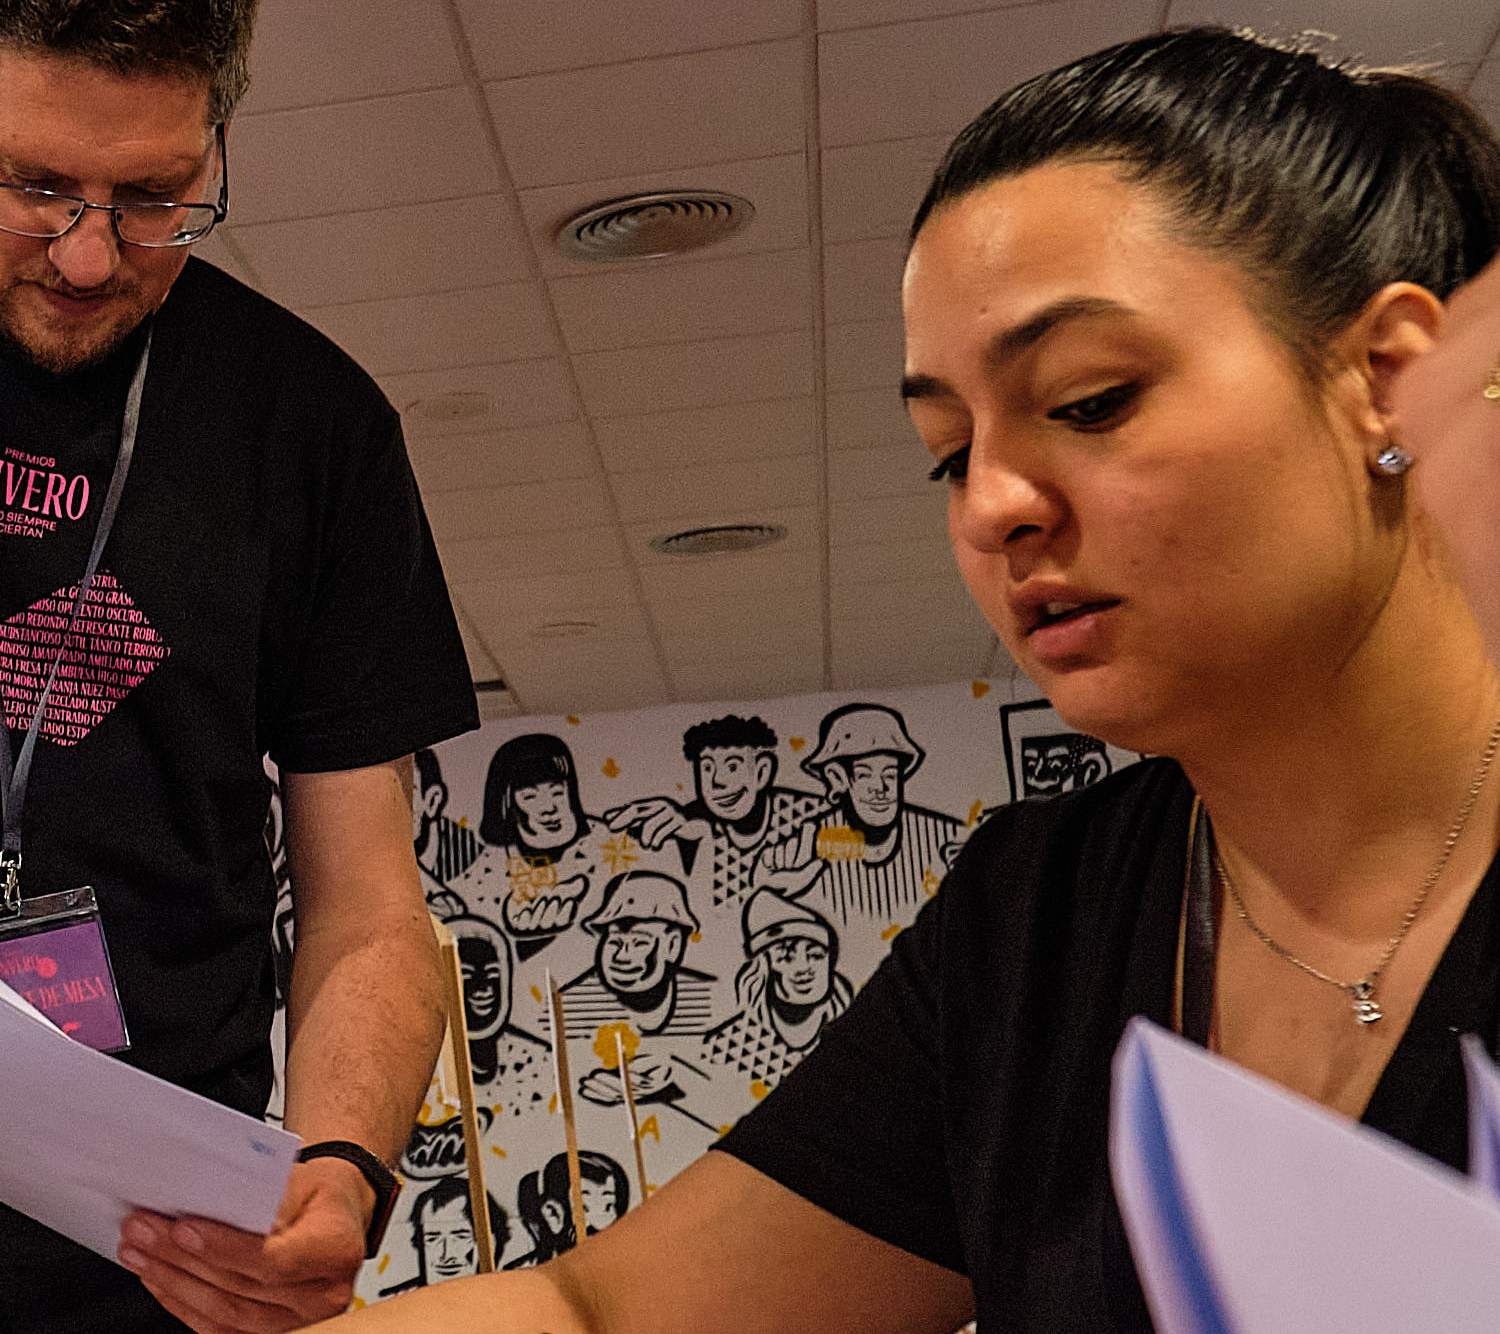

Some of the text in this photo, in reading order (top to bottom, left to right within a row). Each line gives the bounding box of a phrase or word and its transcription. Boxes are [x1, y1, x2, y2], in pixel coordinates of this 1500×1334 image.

[5, 446, 56, 468] PREMIOS
[6, 511, 57, 532] SIEMPRE
[69, 586, 104, 602] GOOSO
[27, 613, 69, 630] REDONDO
[123, 641, 164, 659] TERROSO
[15, 656, 41, 674] FRESA
[13, 673, 38, 689] MORA
[40, 677, 78, 697] NRANJA
[81, 682, 104, 696] NUEZ
[27, 703, 90, 725] COCENTRADO
[63, 976, 107, 1004] MESA
